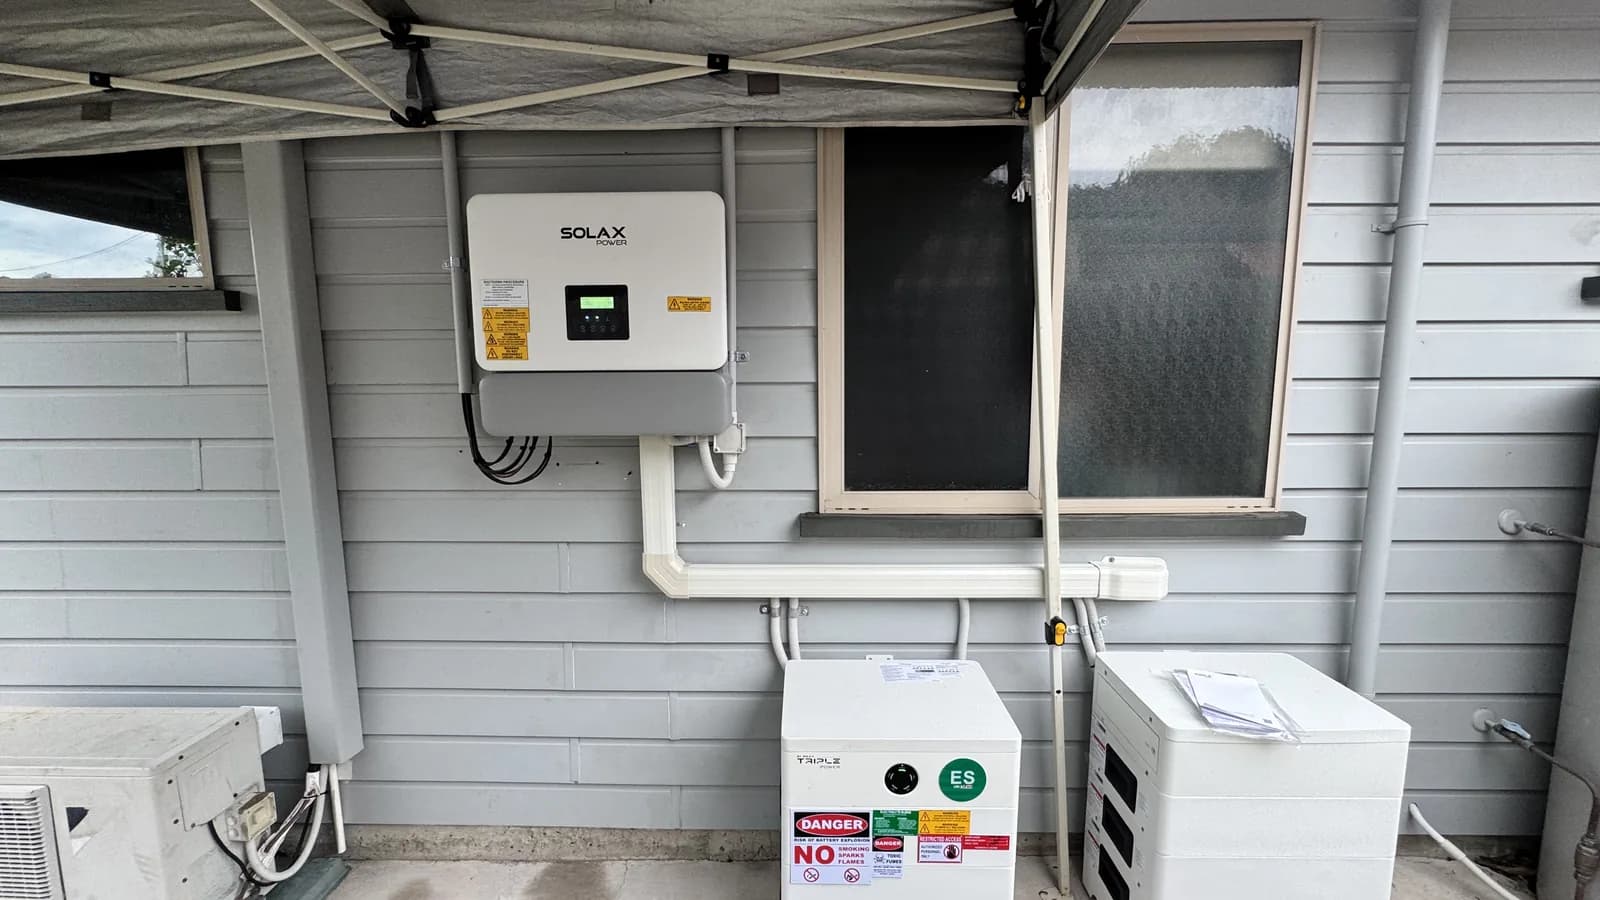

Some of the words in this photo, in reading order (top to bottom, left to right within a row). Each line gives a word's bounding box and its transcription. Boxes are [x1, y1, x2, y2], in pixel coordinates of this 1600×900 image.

[560, 226, 626, 239] SOLAX
[950, 770, 975, 785] ES
[801, 819, 864, 830] DANGER
[794, 845, 835, 865] NO
